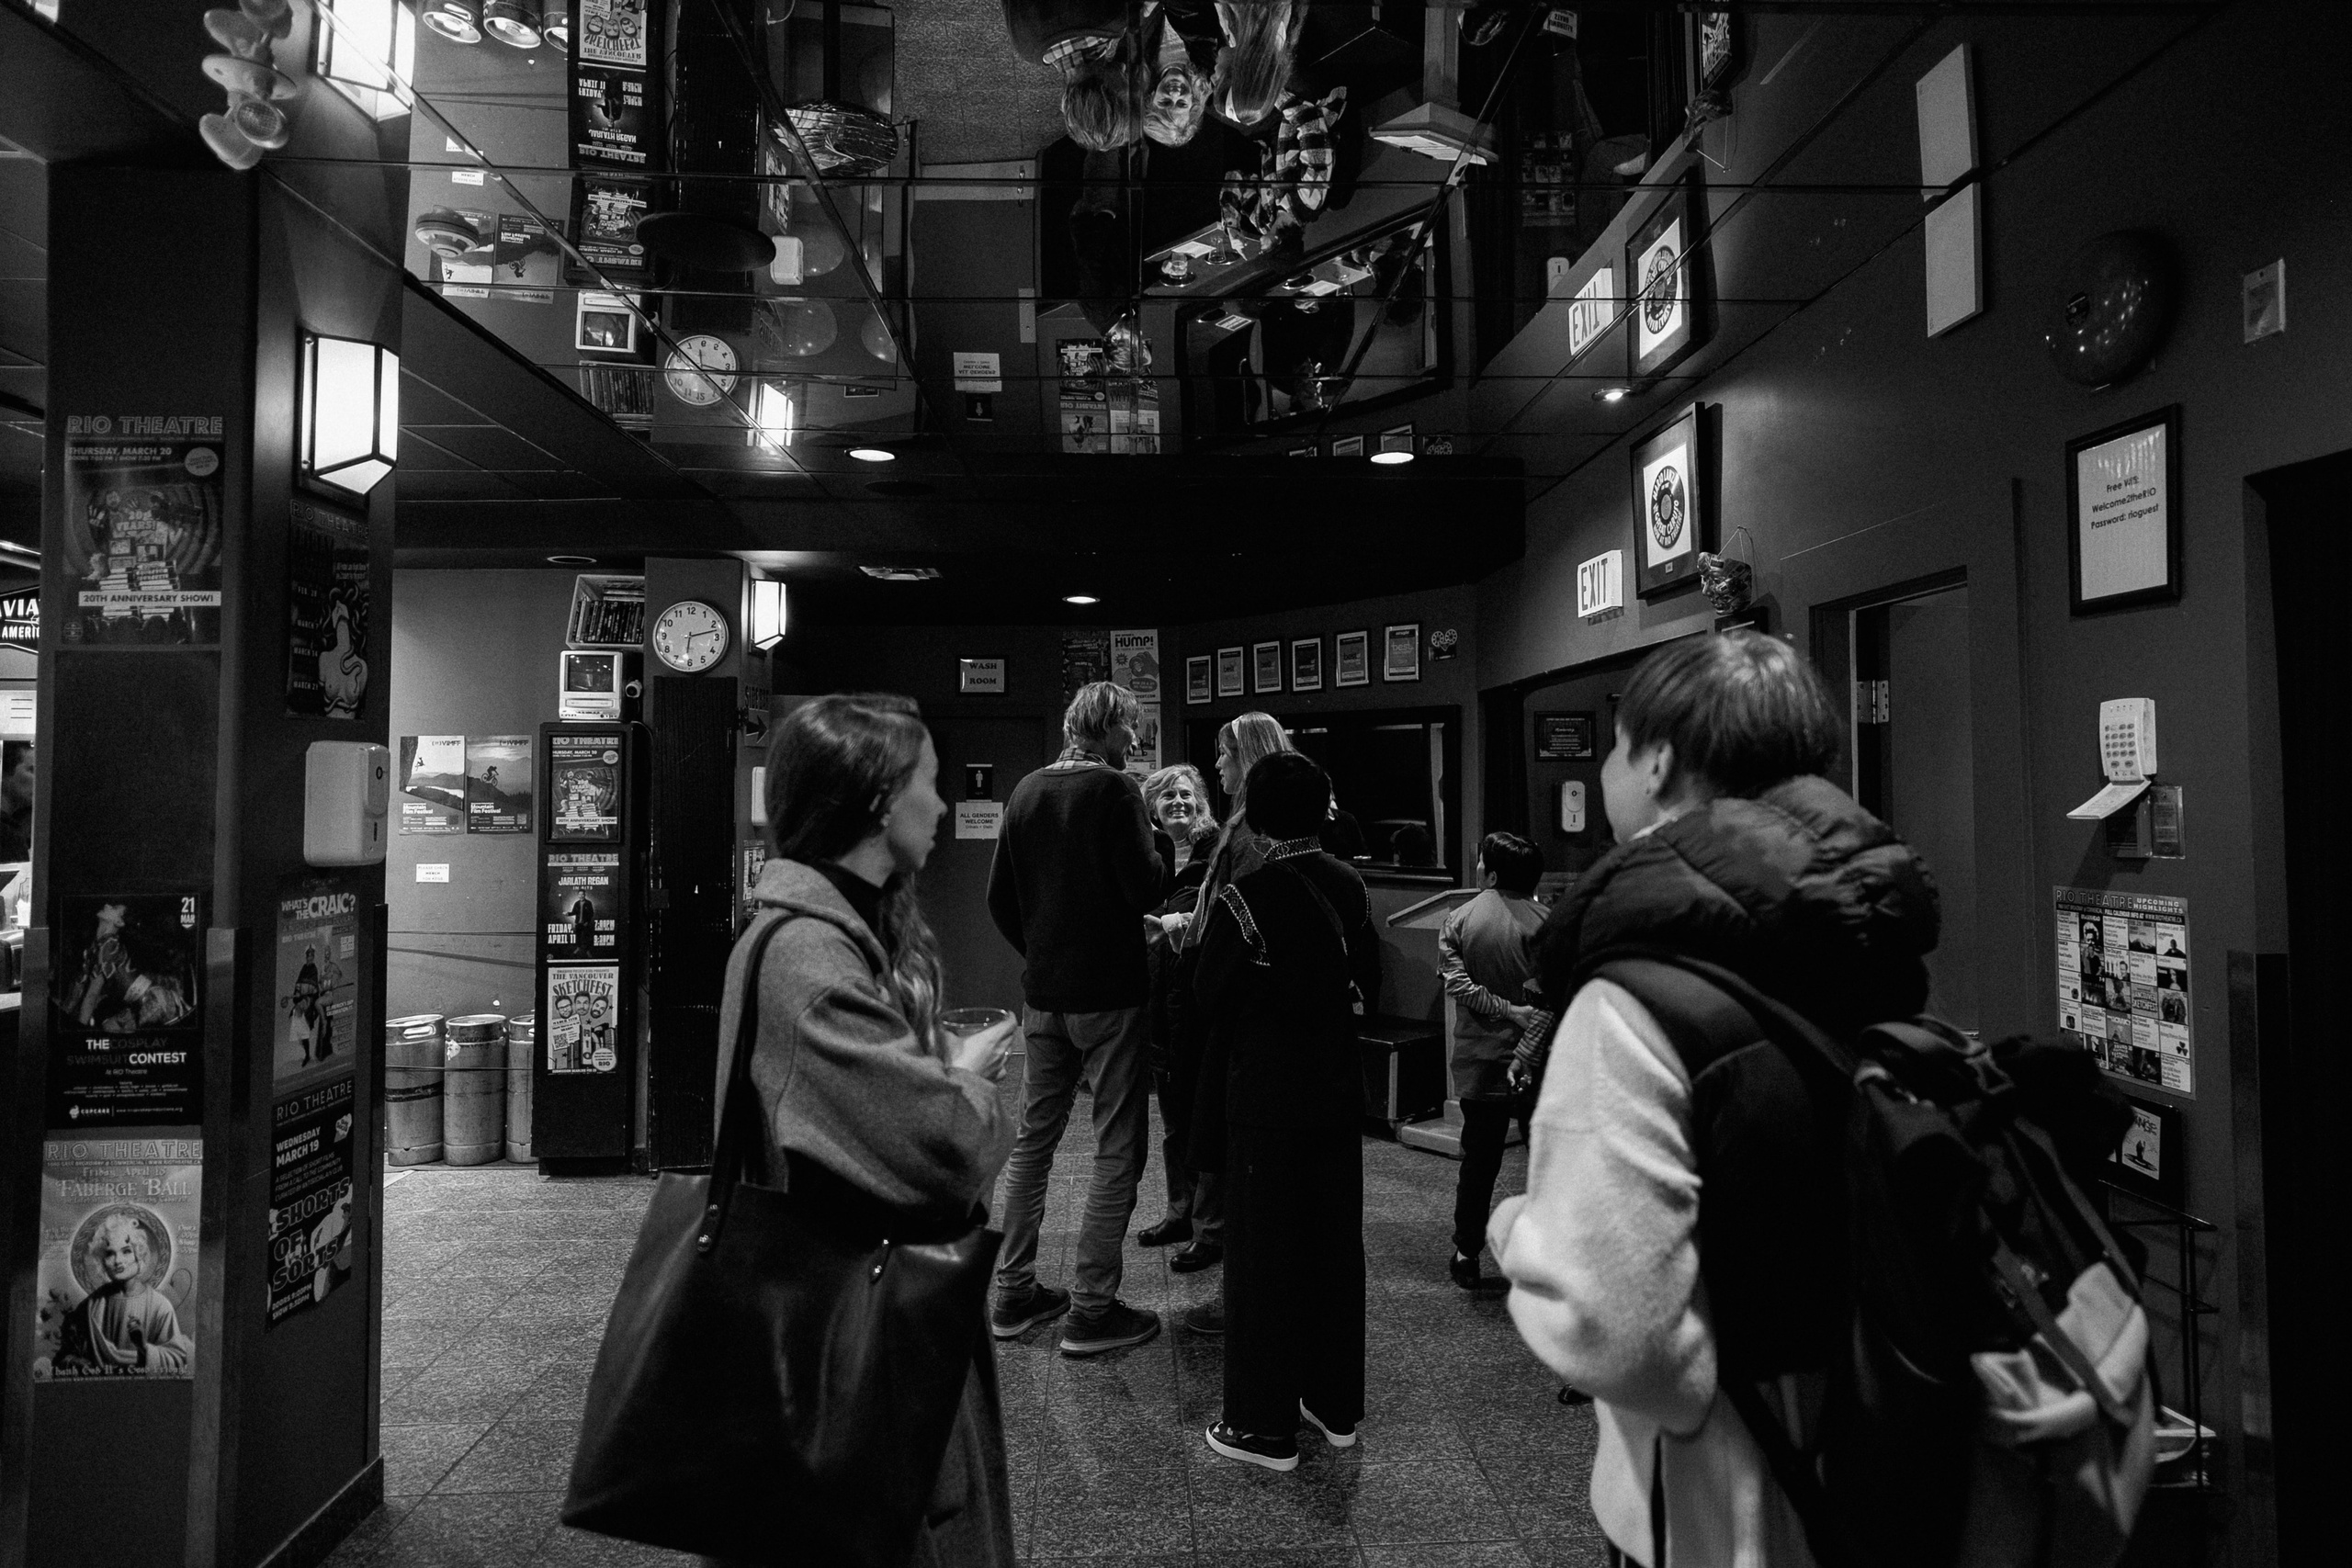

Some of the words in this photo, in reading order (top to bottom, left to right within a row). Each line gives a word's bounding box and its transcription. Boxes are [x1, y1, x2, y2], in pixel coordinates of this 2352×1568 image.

[67, 415, 111, 434] RIO
[119, 415, 223, 434] THEATRE
[122, 446, 157, 456] MARCH
[160, 446, 172, 456] 20
[2107, 482, 2122, 493] Free
[2091, 487, 2156, 513] Welcome2theRIO
[290, 499, 314, 522] RO
[2090, 513, 2126, 530] Password:
[2128, 502, 2159, 519] rioguest
[1581, 558, 1608, 611] EXIT
[84, 594, 107, 603] 20TH
[110, 594, 177, 603] ANNIVERSARY
[180, 593, 214, 603] SHOW!
[0, 598, 40, 618] VIA
[1114, 636, 1154, 648] HUMP!
[548, 853, 569, 863] RIO
[571, 853, 618, 863] THEATRE
[559, 876, 587, 886] JARLATH
[588, 876, 609, 886] REGAN
[181, 897, 196, 913] 21
[281, 897, 309, 912] WHAT'S
[308, 892, 356, 919] CRAIC?
[2056, 889, 2076, 903] RIO
[2080, 891, 2133, 909] THEATRE
[2136, 897, 2179, 908] UPCOMING
[295, 909, 311, 920] THE
[2133, 903, 2185, 916] HIGHLIGHTS
[548, 923, 574, 934] FRIDAY,
[548, 933, 569, 944] APRIL
[570, 933, 577, 944] 11
[552, 978, 614, 997] SKETCHFEST
[85, 1038, 110, 1050] THE
[110, 1036, 168, 1050] COSPLAY
[129, 1052, 187, 1065] CONTEST
[277, 1101, 300, 1121] RIO
[303, 1080, 353, 1110] THEATRE
[276, 1125, 321, 1153] WEDNESDAY
[47, 1143, 87, 1160] RIO
[99, 1141, 203, 1159] THEATRE
[276, 1144, 309, 1168] MARCH
[310, 1139, 320, 1153] 19
[276, 1176, 351, 1233] SHORTS
[274, 1229, 303, 1262] OF
[273, 1236, 338, 1292] SORTS
